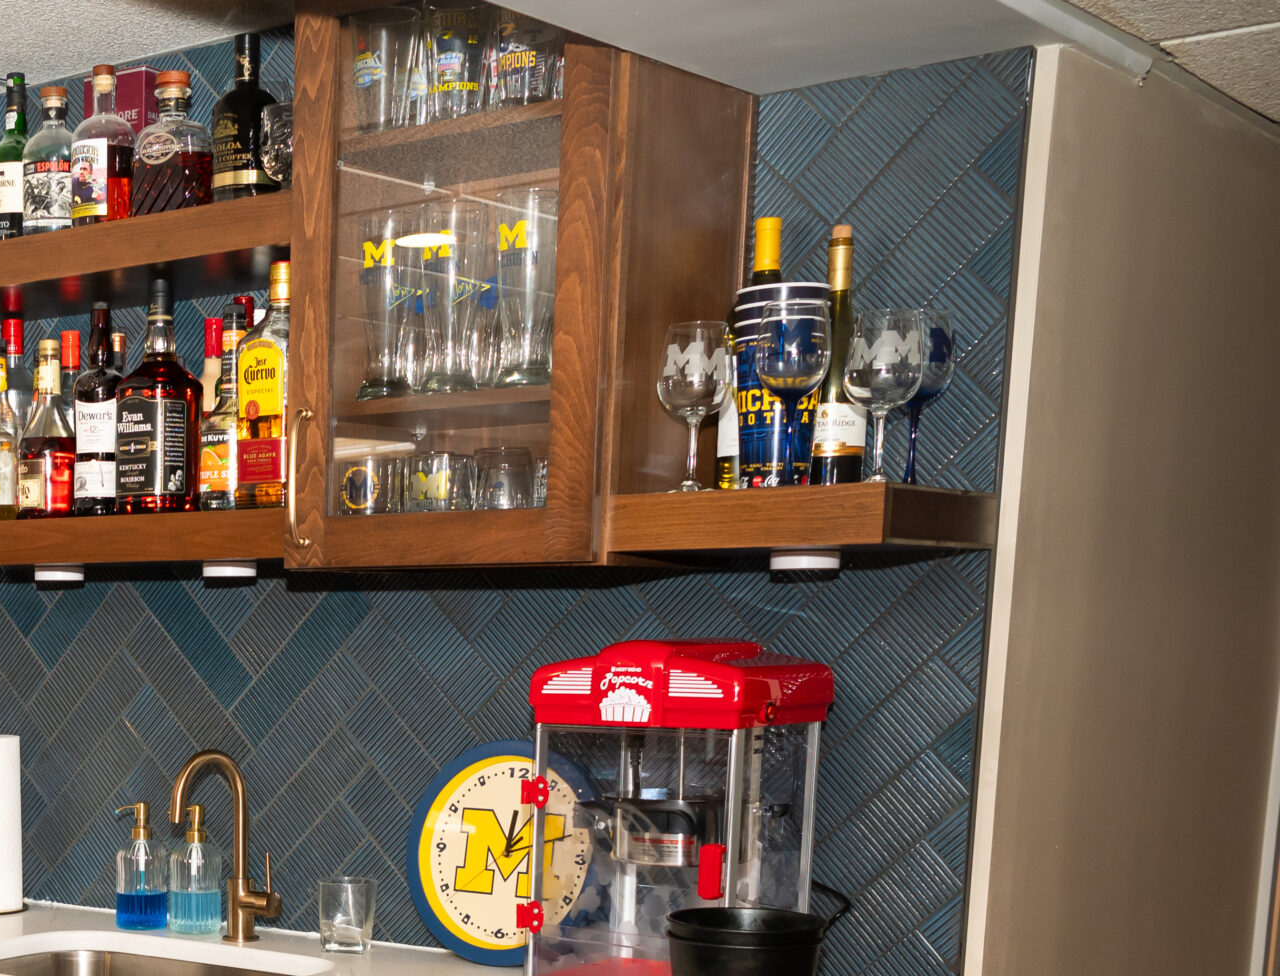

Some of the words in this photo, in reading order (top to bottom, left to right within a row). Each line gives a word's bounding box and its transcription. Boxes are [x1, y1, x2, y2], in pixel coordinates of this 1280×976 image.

[498, 220, 529, 251] M
[363, 239, 395, 268] M
[244, 367, 276, 385] Cuervo
[78, 411, 113, 422] Dewar's
[122, 411, 144, 423] Evan
[119, 463, 146, 471] KENTUCKY
[120, 475, 145, 484] BOURBON
[600, 672, 653, 690] Popcorn
[508, 767, 530, 779] 12
[436, 842, 447, 853] 9
[574, 853, 586, 866] 3
[493, 927, 506, 939] 6
